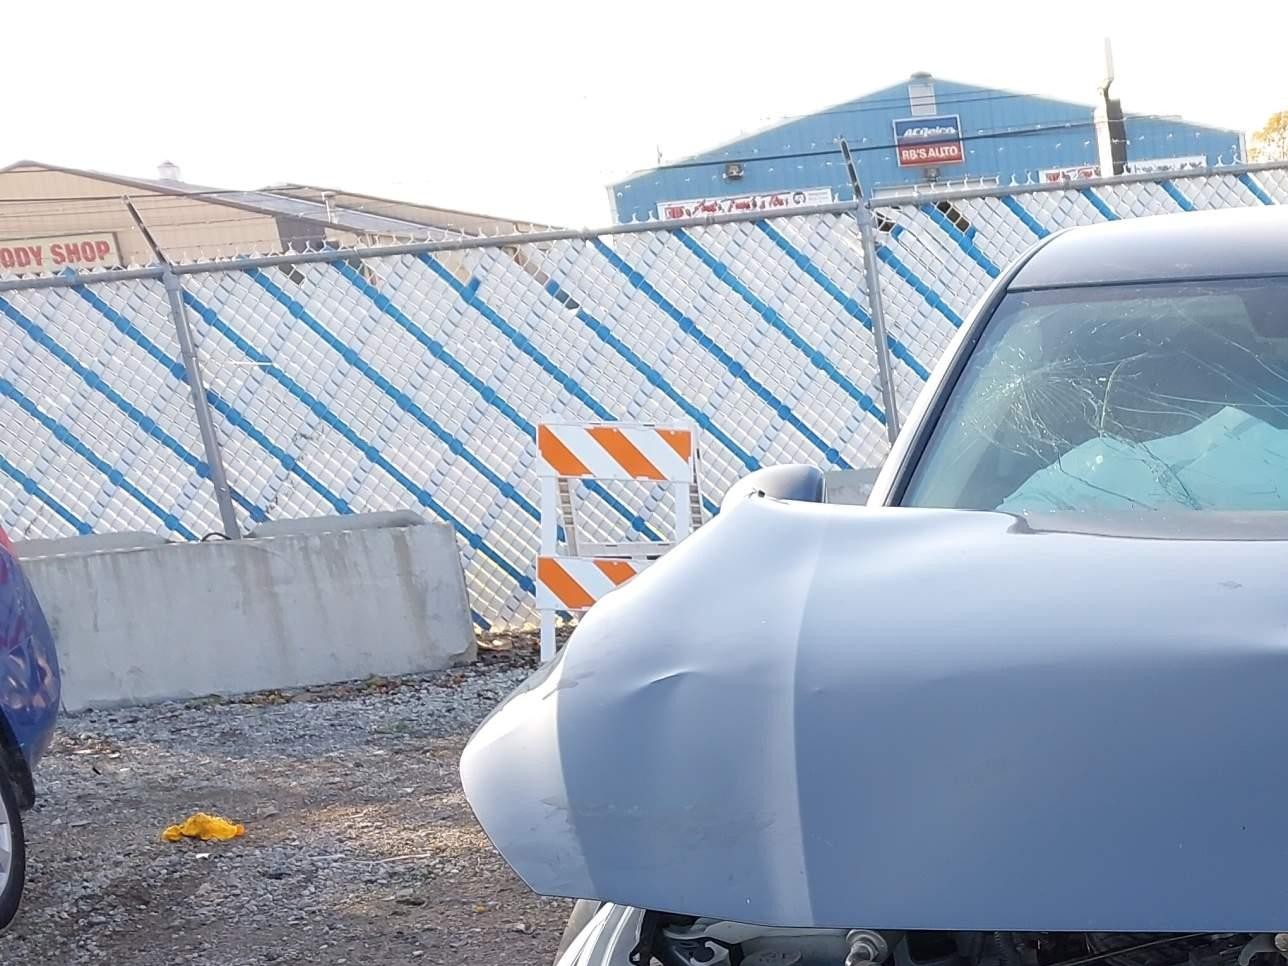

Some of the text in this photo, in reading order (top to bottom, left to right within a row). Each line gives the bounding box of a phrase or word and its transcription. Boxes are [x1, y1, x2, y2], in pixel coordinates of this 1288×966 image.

[902, 146, 958, 160] RB'S AUTO
[50, 241, 110, 264] SHOP
